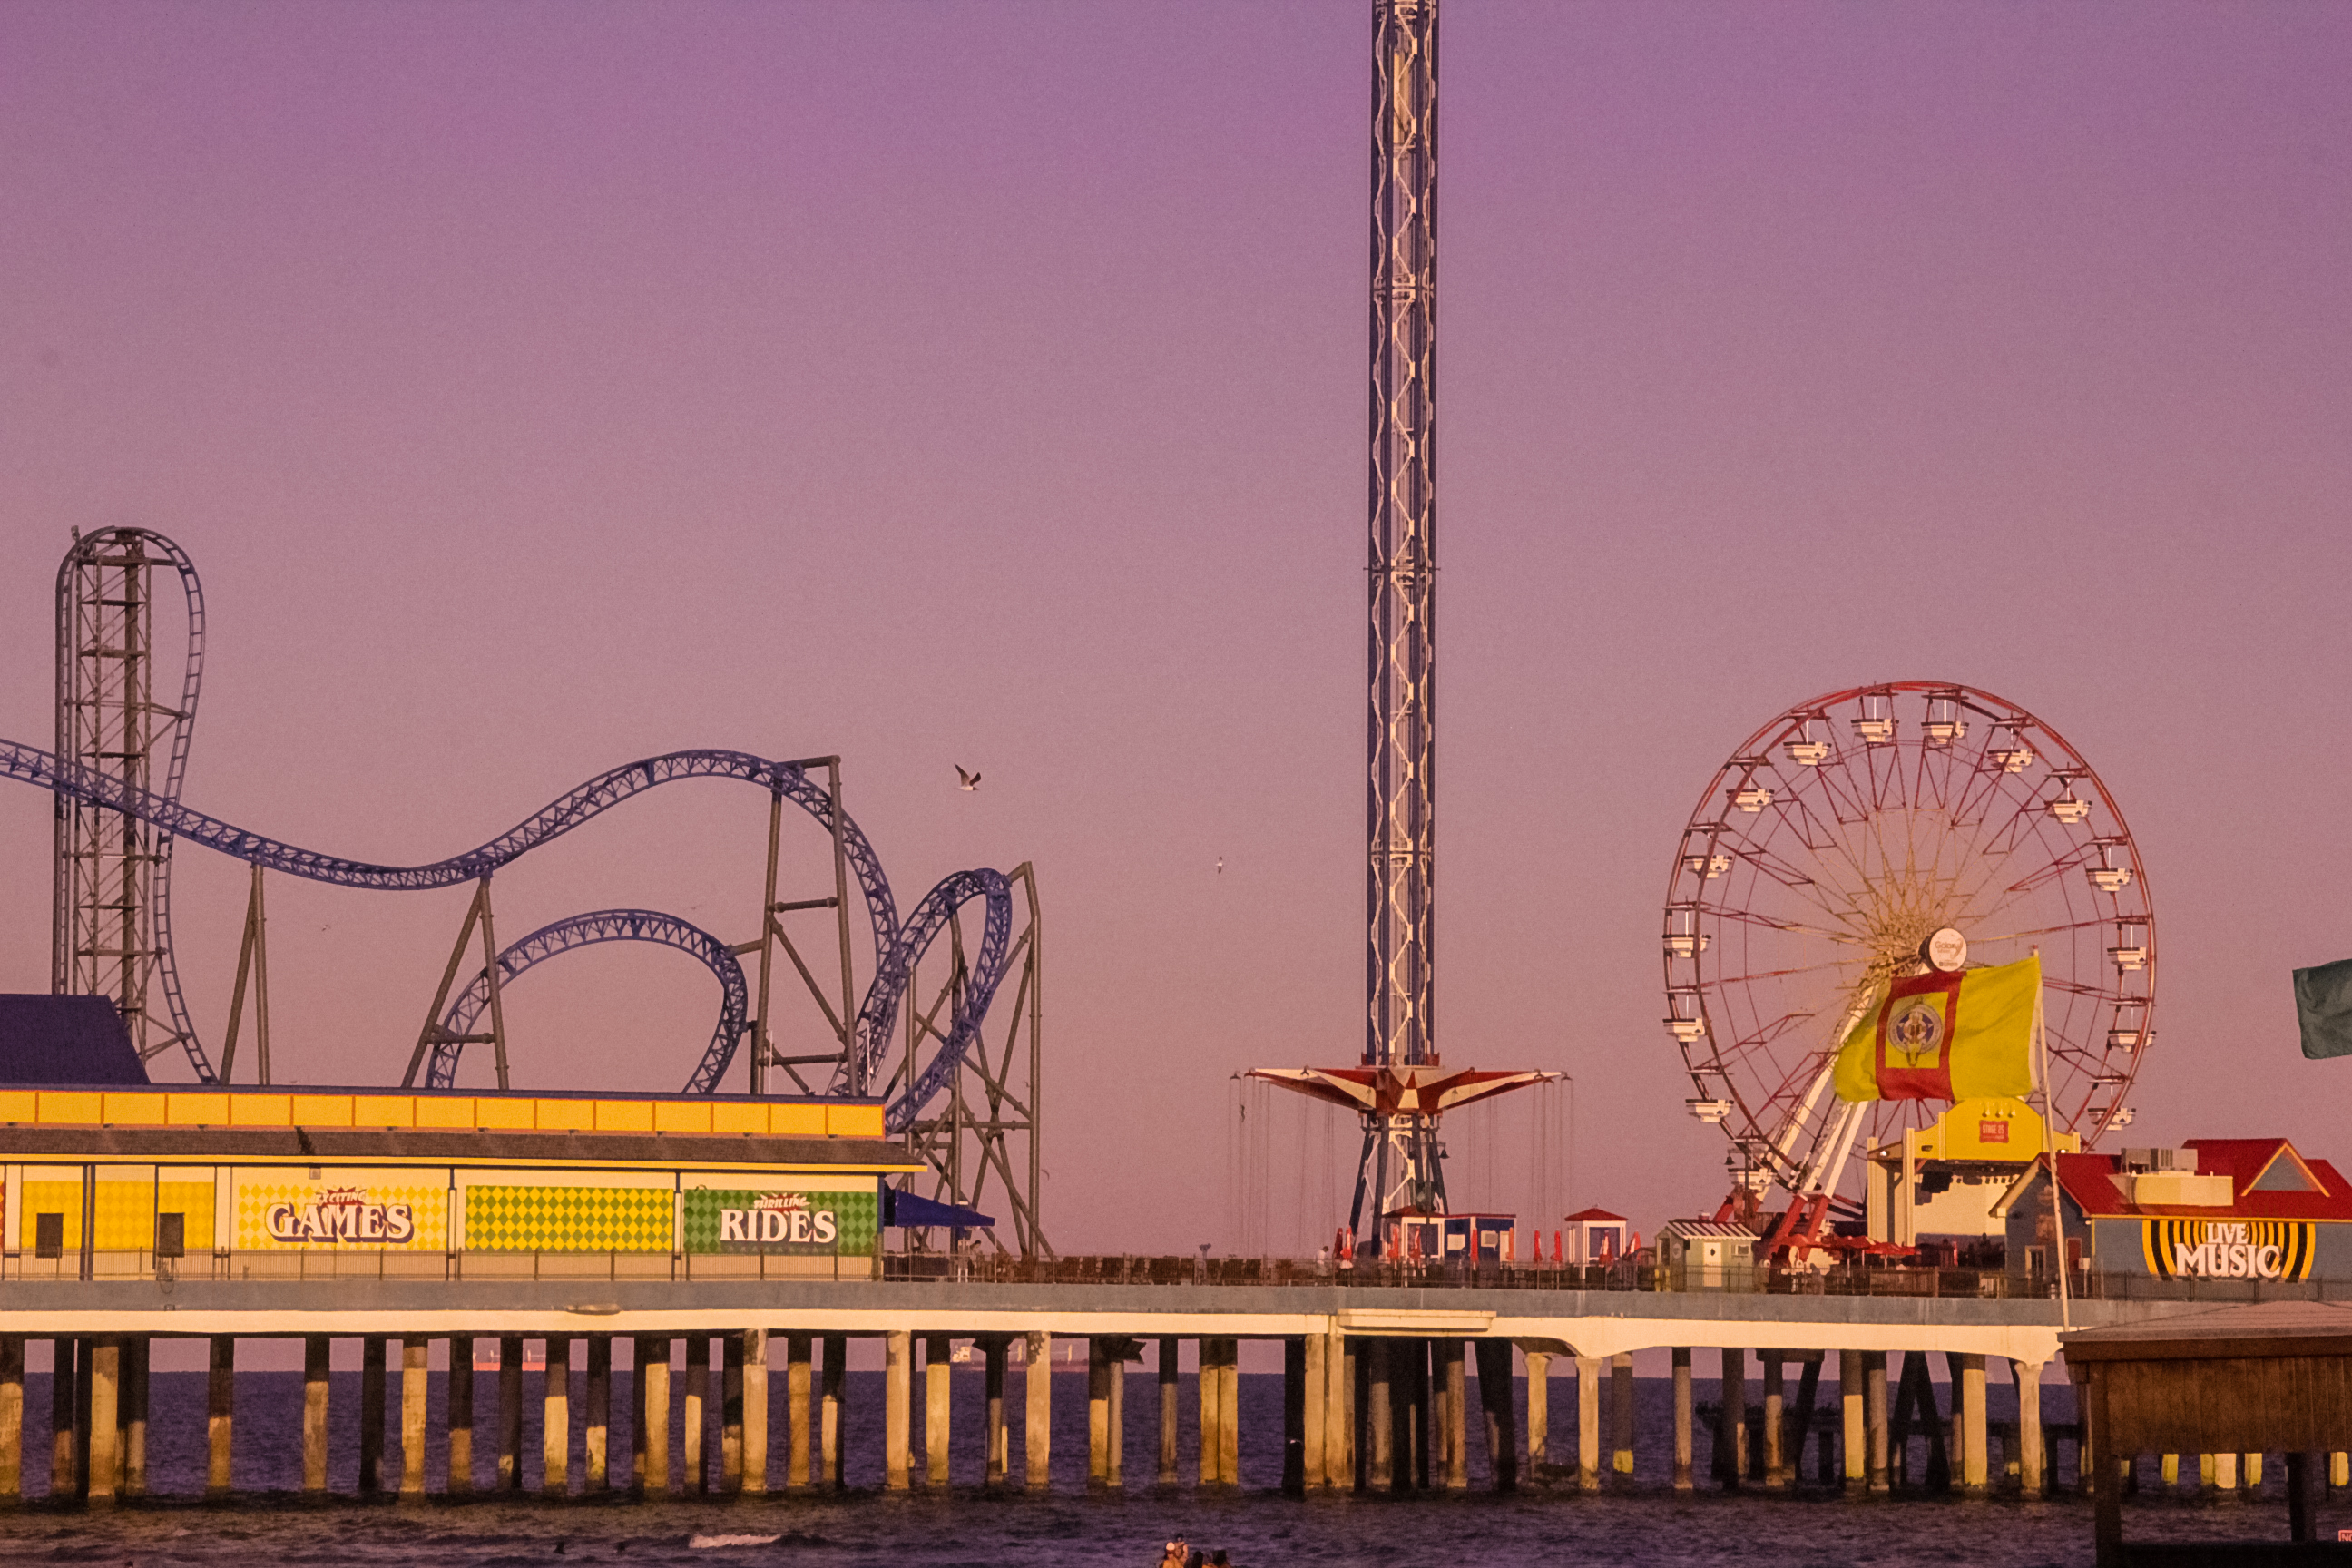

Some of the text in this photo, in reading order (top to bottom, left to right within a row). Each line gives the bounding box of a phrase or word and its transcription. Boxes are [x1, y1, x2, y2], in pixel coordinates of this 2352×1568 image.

[317, 1191, 366, 1205] EXCITING
[754, 1197, 810, 1209] THRILLING
[265, 1202, 414, 1243] GAMES
[720, 1209, 837, 1243] RIDES
[2207, 1222, 2249, 1244] LIVE
[2174, 1243, 2281, 1279] MUSIC
